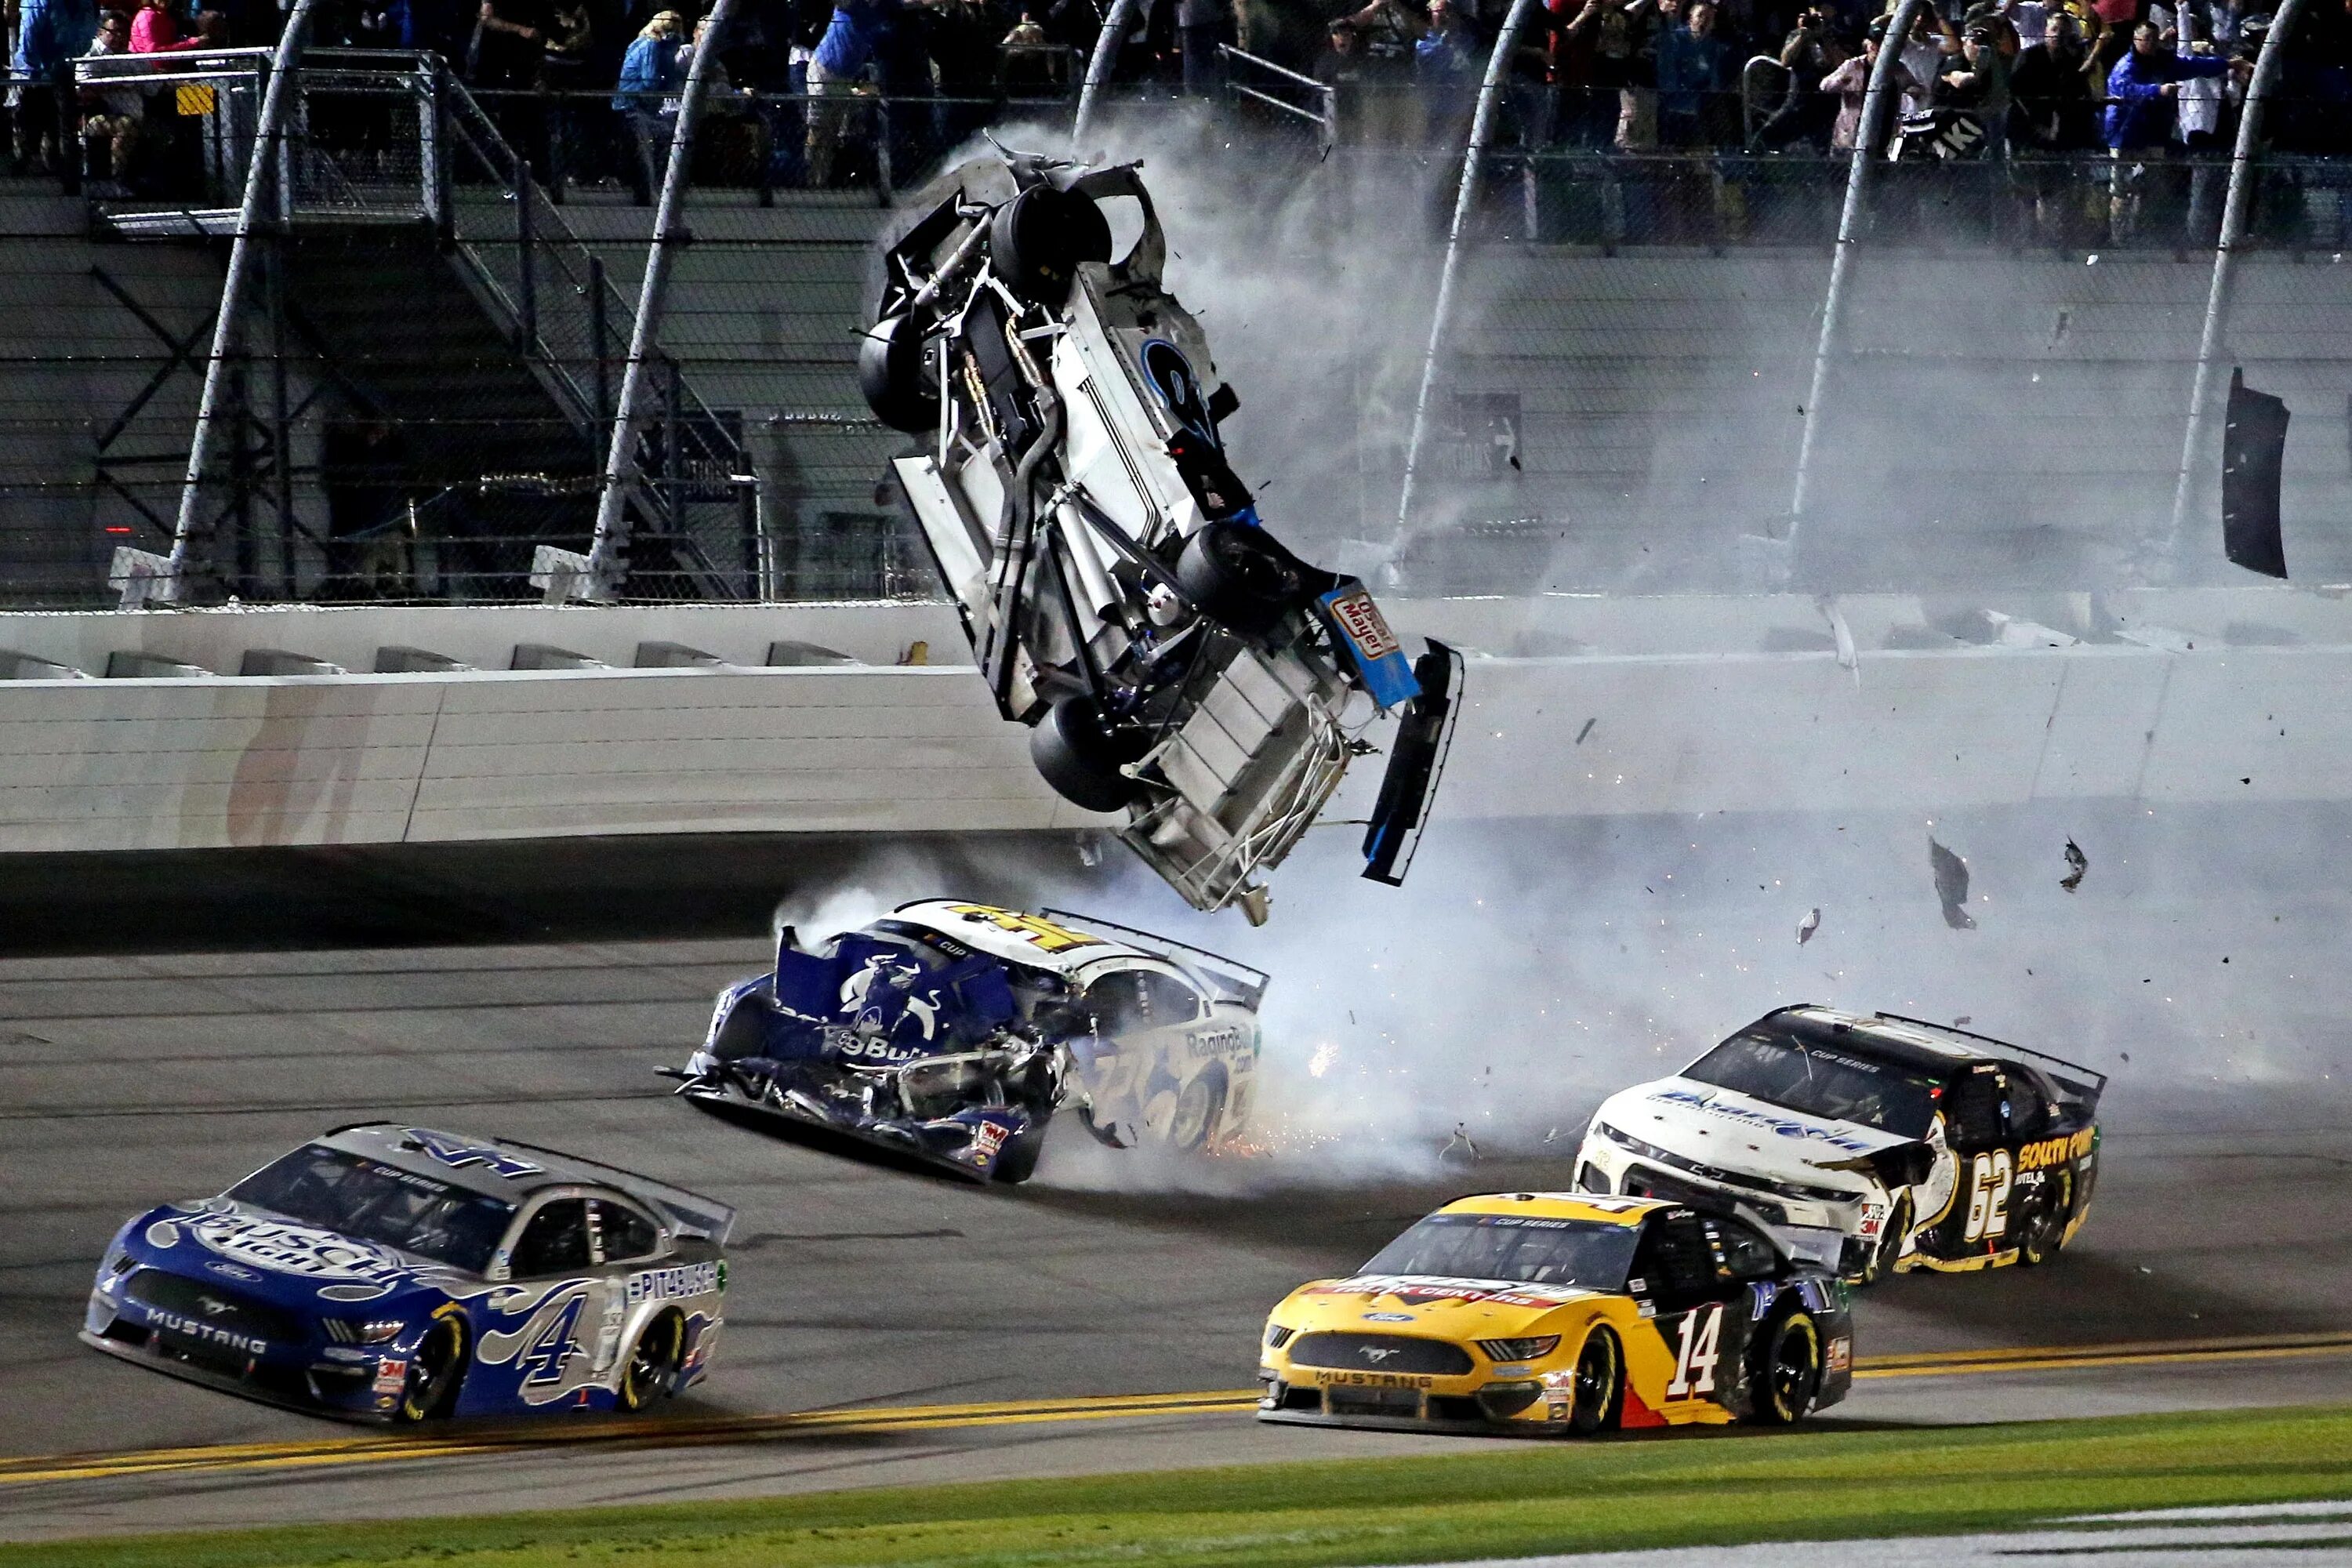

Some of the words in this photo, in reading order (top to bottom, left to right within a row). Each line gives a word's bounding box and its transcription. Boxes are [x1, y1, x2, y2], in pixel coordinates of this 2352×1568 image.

[1343, 602, 1384, 648] Mayer
[939, 941, 967, 957] CUP
[1810, 1050, 1838, 1060] CUP
[1835, 1057, 1880, 1073] SERIES
[372, 1166, 403, 1178] CUP
[2016, 1137, 2070, 1173] SOUTH
[1964, 1147, 2013, 1243] 62
[1494, 1218, 1523, 1226] CUP
[1522, 1218, 1570, 1229] SERIES
[185, 1213, 401, 1284] BUSCH
[146, 1308, 267, 1355] MUSTANG
[524, 1291, 590, 1386] 4
[1665, 1304, 1723, 1399] 14
[1315, 1370, 1432, 1388] MUSTANG
